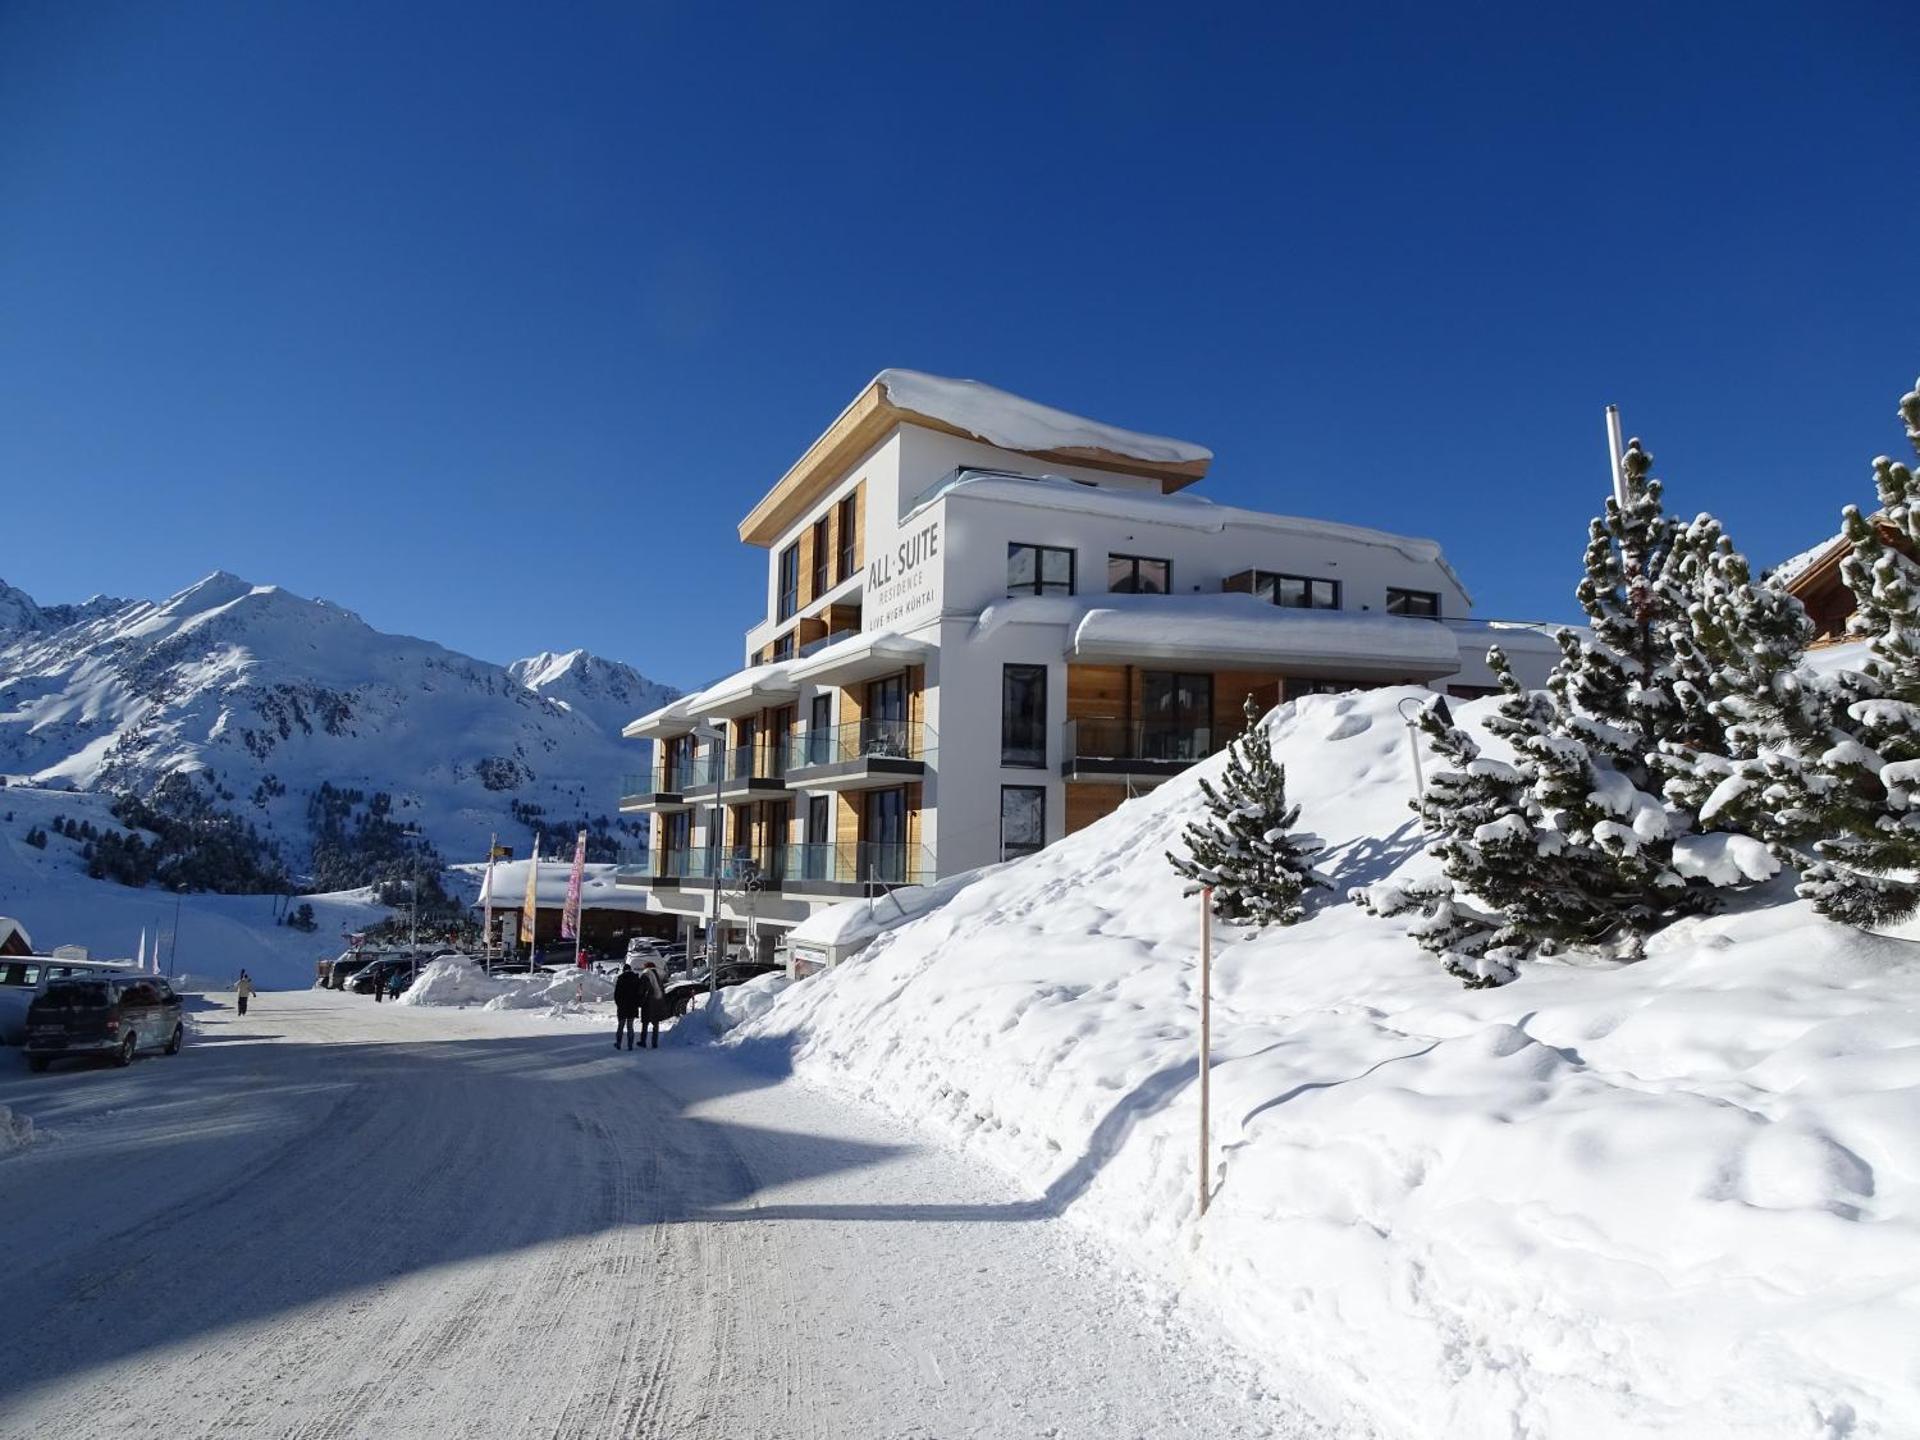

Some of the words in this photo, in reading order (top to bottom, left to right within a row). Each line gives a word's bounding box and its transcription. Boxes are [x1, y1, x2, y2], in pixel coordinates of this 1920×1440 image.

[868, 554, 892, 593] ALL
[898, 522, 939, 576] SUITE
[880, 571, 923, 605] RESIDENCE
[869, 615, 885, 632] LIVE
[886, 605, 904, 624] HIGH
